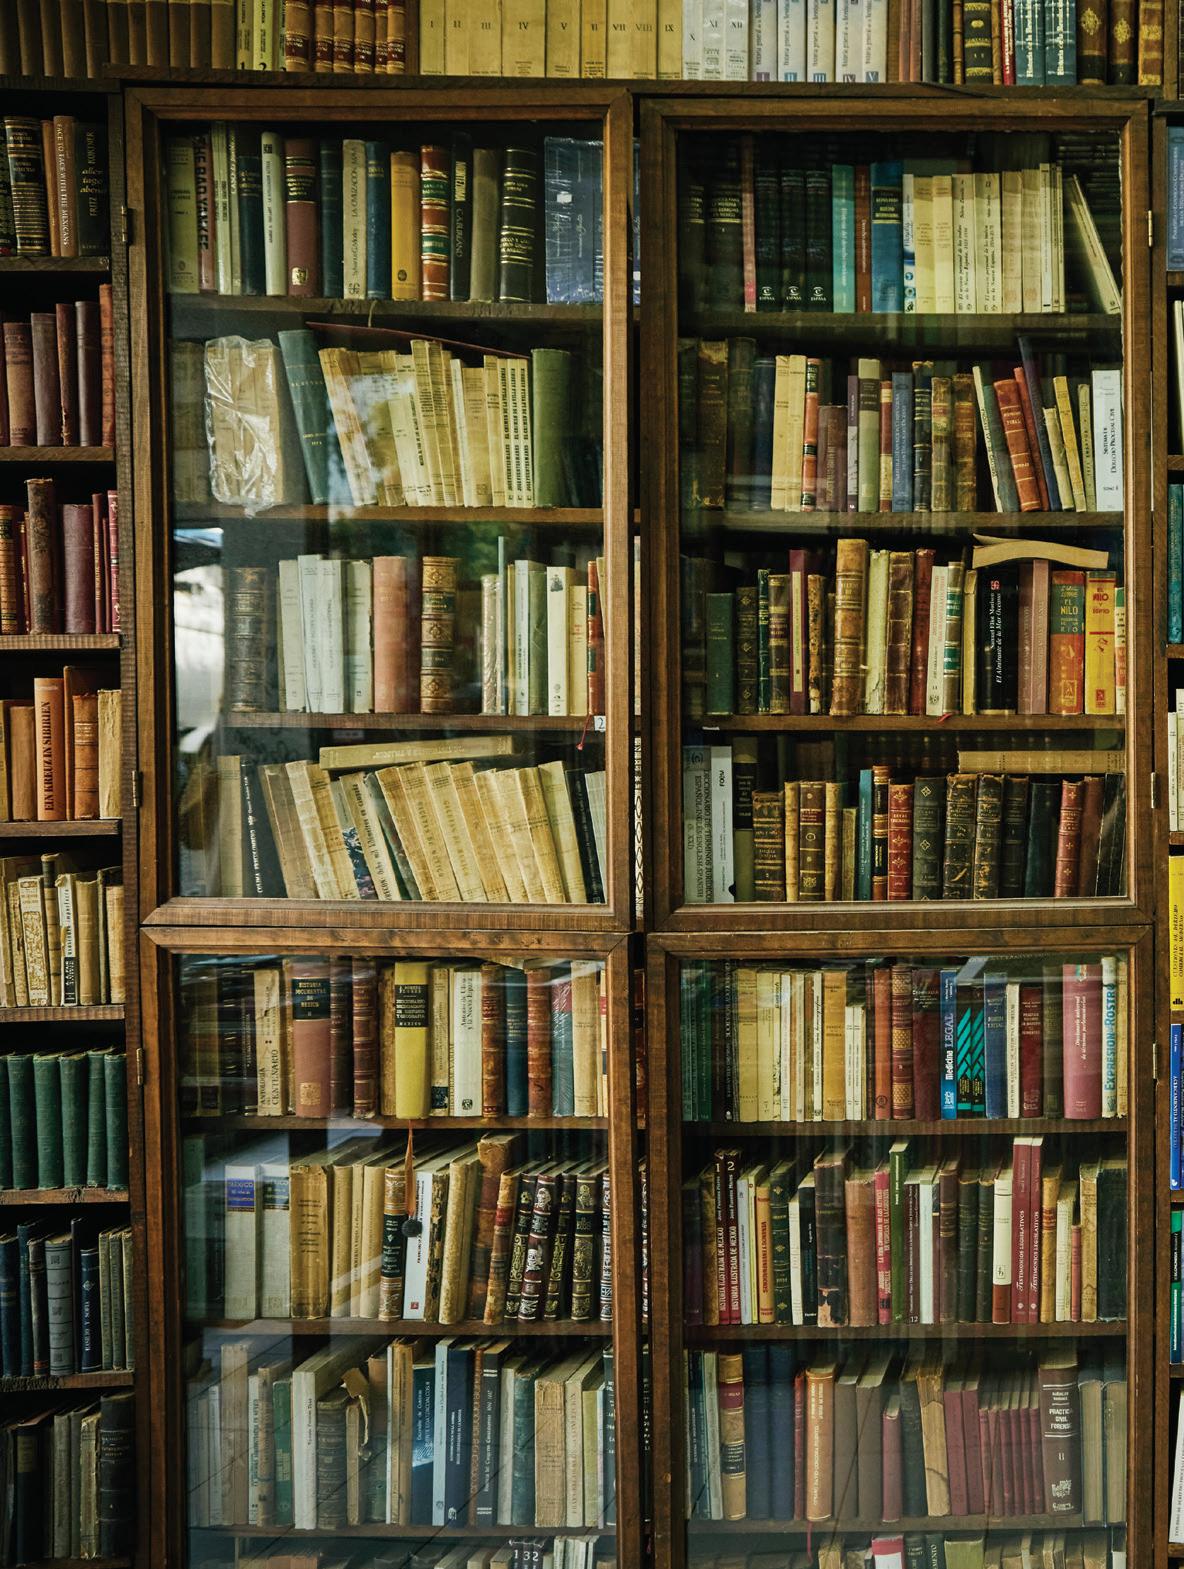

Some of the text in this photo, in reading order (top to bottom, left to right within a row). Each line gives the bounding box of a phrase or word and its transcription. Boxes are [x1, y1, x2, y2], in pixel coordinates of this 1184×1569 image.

[61, 209, 69, 246] MEXICANS
[1060, 606, 1079, 616] NILO
[41, 701, 55, 811] EIN KREUZ IN SIBIRIEN
[703, 769, 712, 818] DICCIONARIO
[945, 1013, 954, 1047] LEGAL
[270, 1050, 279, 1105] CENTENARIO
[945, 1050, 954, 1080] Medicina
[1104, 1034, 1116, 1091] EXPRESION
[1016, 1210, 1026, 1291] TESTIMONIOS LEGISLATIVOS
[730, 1255, 738, 1284] ILUSTRADA
[730, 1285, 738, 1310] HISTORIA
